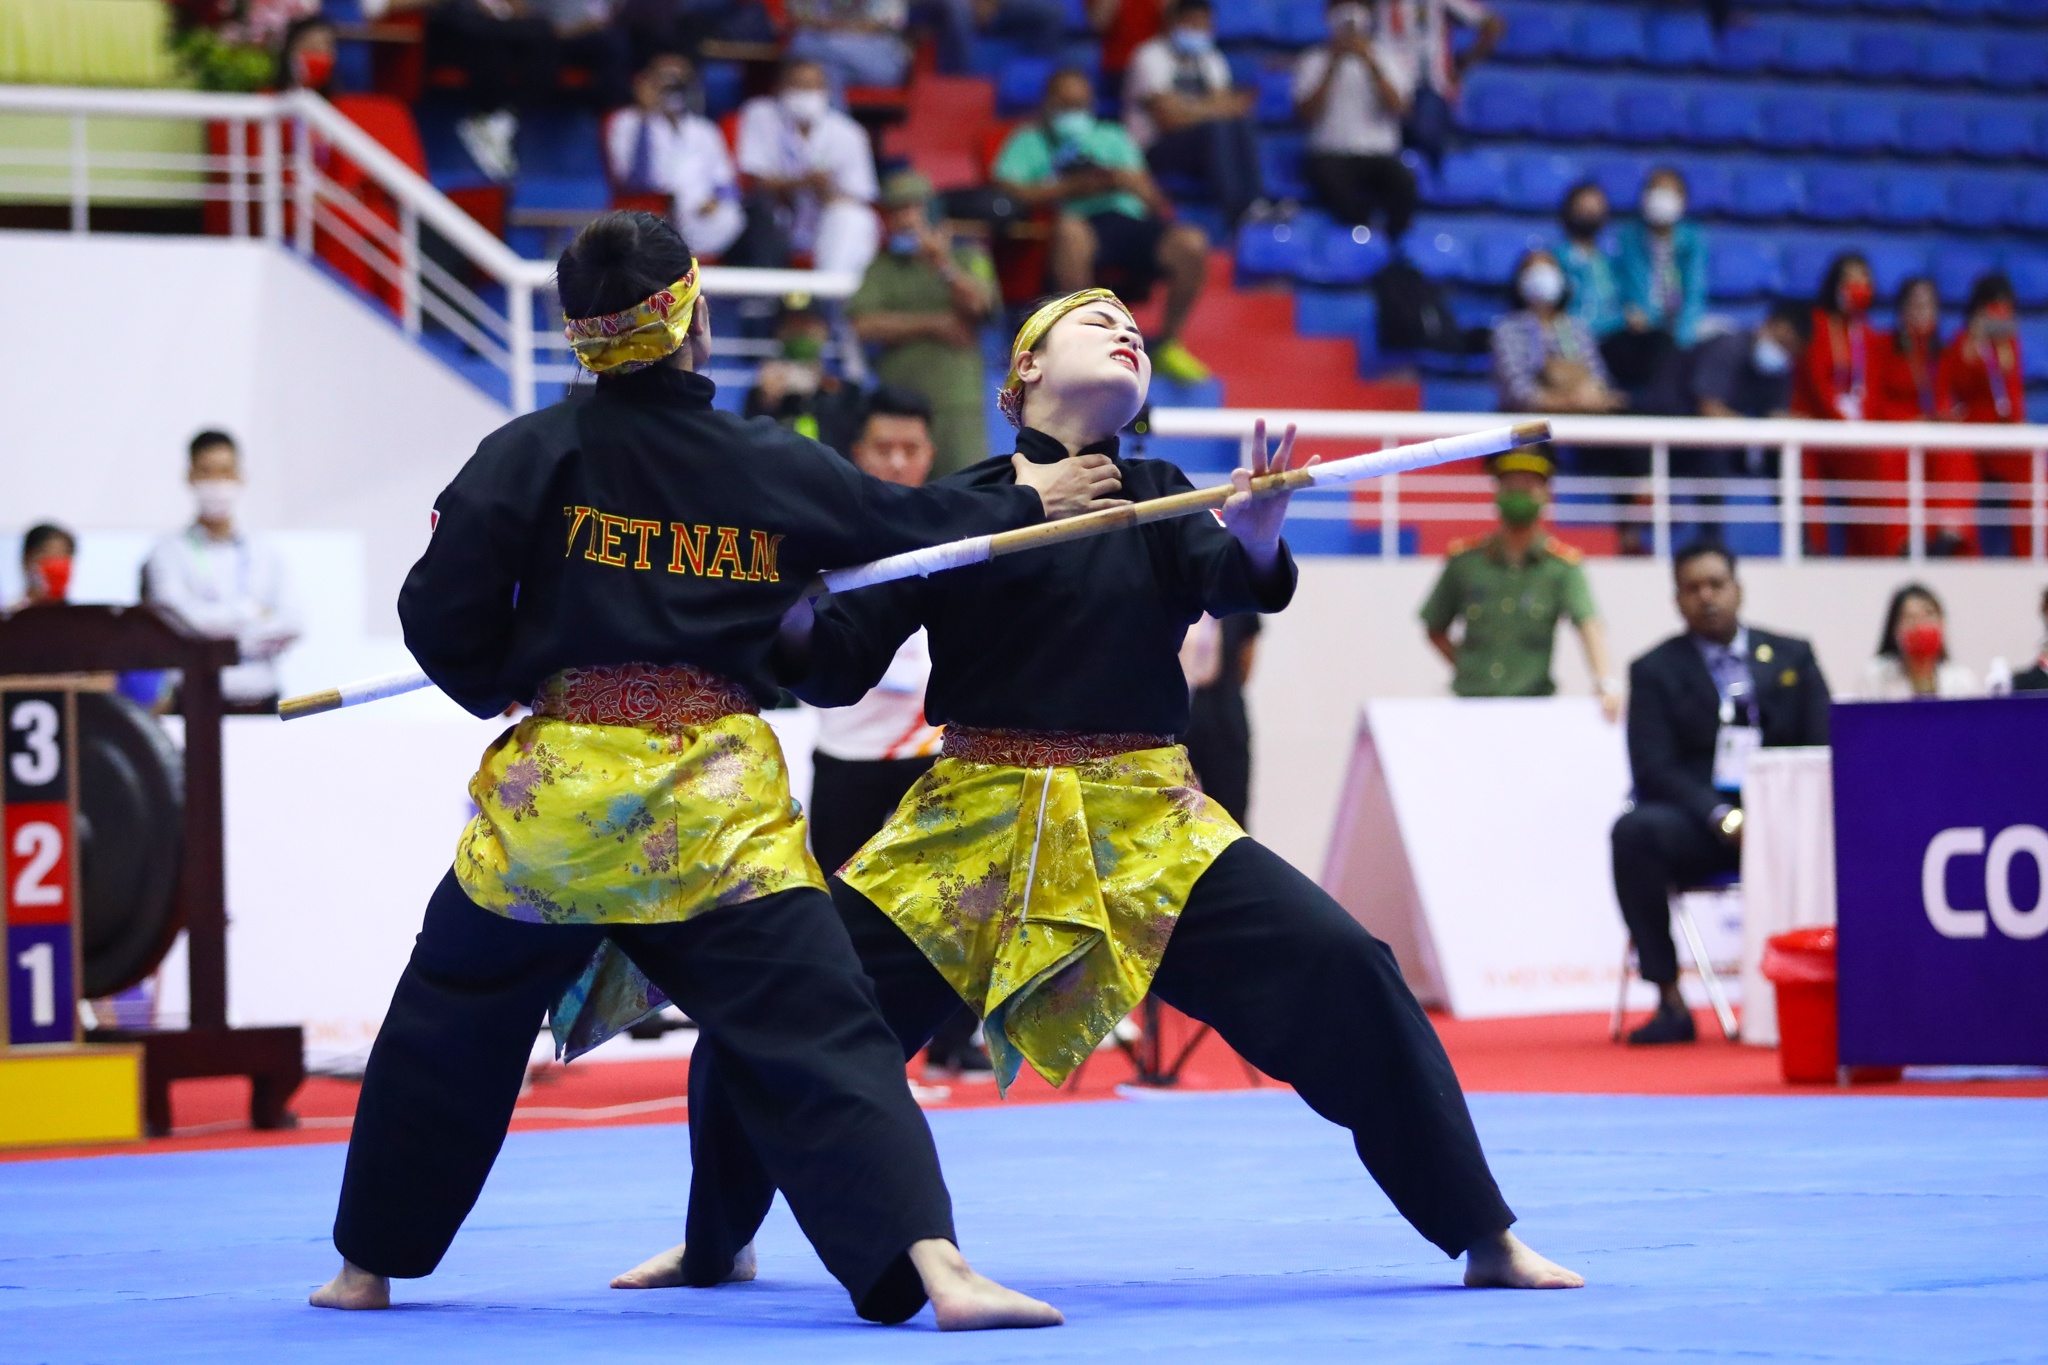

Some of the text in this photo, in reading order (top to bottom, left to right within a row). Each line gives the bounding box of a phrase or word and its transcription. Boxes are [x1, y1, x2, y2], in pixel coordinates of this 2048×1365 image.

[563, 505, 786, 582] VIET NAM
[10, 699, 60, 786] 3
[13, 821, 63, 907] 2
[1921, 823, 2048, 941] CO
[18, 943, 55, 1026] 1
